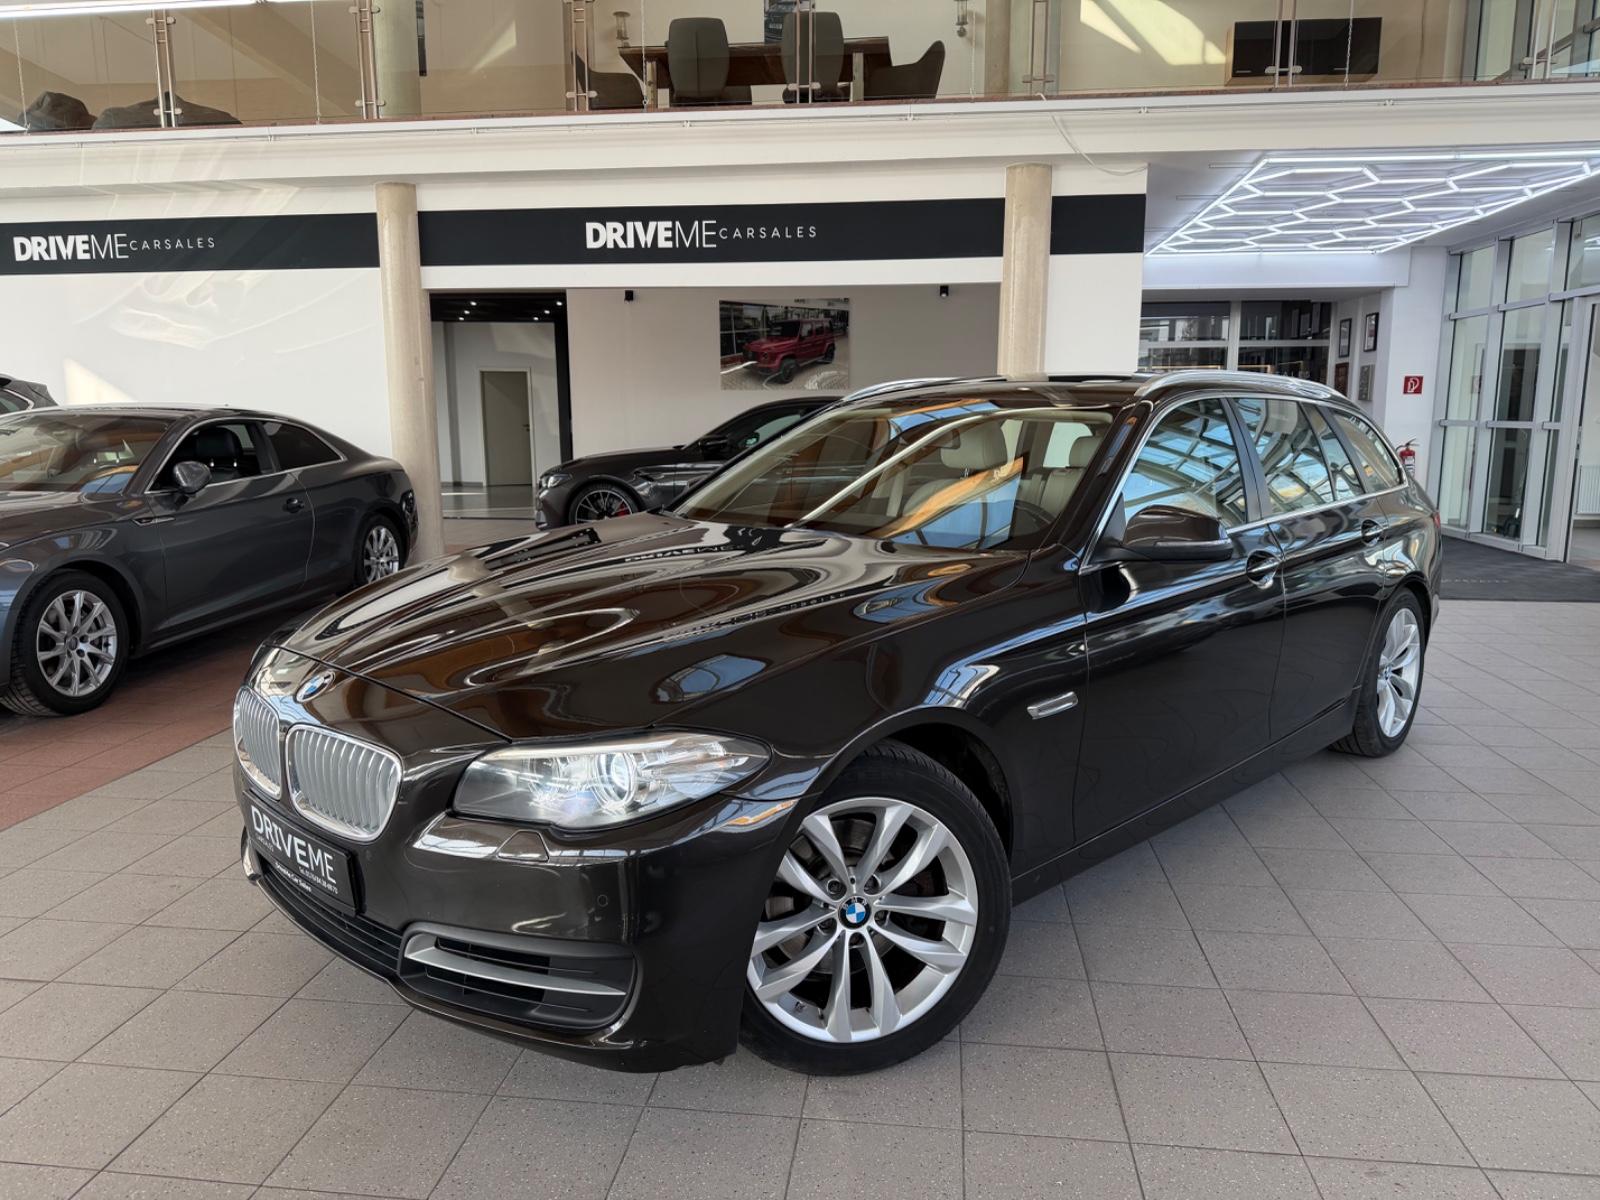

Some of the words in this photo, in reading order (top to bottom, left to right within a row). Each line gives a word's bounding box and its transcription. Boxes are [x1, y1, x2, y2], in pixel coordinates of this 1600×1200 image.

[13, 233, 130, 262] DRIVEME
[129, 237, 215, 251] CARSALES
[585, 220, 717, 249] DRIVEME
[719, 226, 818, 239] CARSALES
[251, 804, 337, 885] DRIVEME
